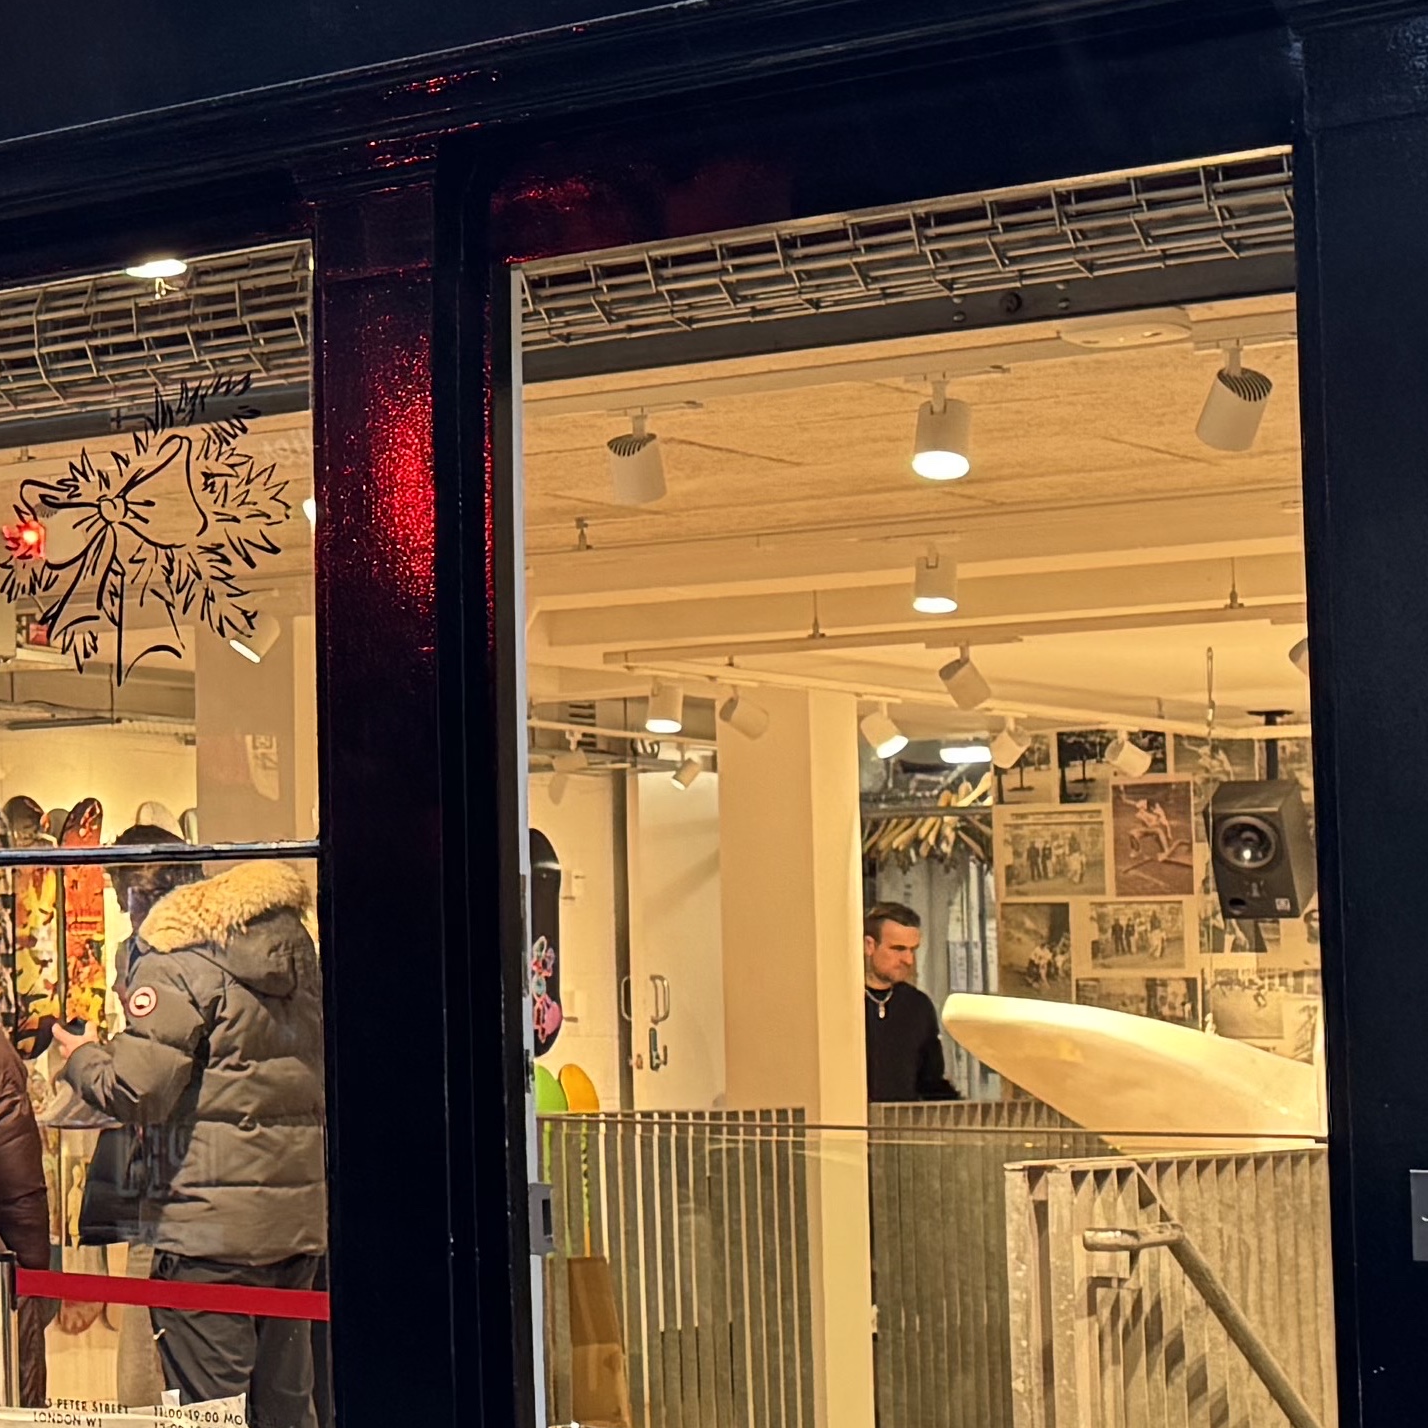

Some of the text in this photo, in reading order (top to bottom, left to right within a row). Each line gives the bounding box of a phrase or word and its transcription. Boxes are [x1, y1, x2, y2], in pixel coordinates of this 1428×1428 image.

[57, 1398, 87, 1412] PETER
[92, 1401, 128, 1414] STREET
[34, 1412, 102, 1428] LONDON W1
